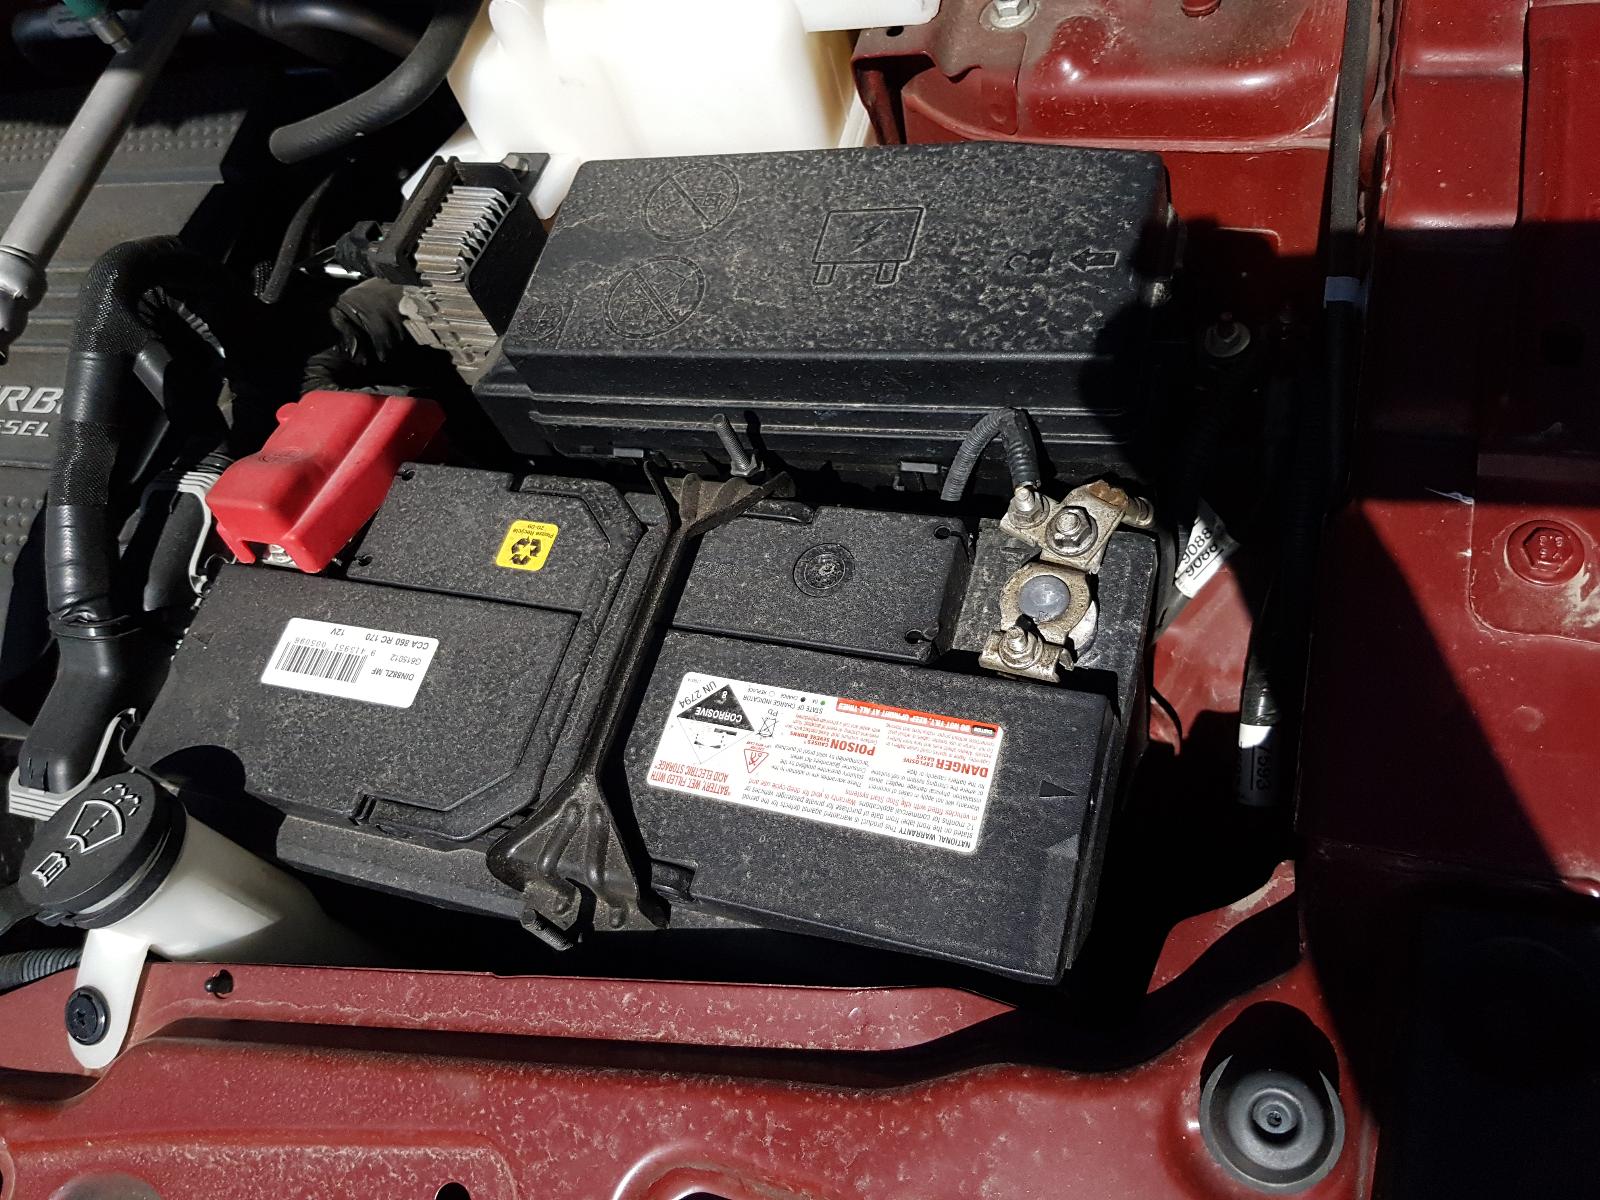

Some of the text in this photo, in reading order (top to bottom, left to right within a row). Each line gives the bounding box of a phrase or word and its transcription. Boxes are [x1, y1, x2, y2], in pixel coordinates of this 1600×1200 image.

[0, 386, 63, 414] RB
[0, 419, 49, 437] SEL
[1182, 528, 1212, 564] 9088
[329, 626, 429, 650] CCA 860 RC 170 12V
[370, 666, 383, 675] MF
[679, 681, 716, 708] UN 2794
[721, 690, 728, 699] 8
[741, 694, 772, 705] INDICATOR
[771, 699, 796, 709] CHARGE
[804, 705, 823, 714] STATE
[694, 706, 742, 722] CORROSIVE
[829, 738, 875, 756] POISON
[902, 756, 934, 767] EXPLOSIVE
[934, 758, 989, 777] DANGER
[649, 770, 667, 782] WITH
[683, 765, 713, 779] ELECTRIC
[712, 771, 728, 782] ACID
[665, 773, 687, 786] FILLED
[760, 796, 770, 804] the
[859, 818, 883, 829] product
[884, 813, 900, 823] from
[941, 817, 965, 828] months
[898, 826, 936, 840] WARRANTY
[931, 823, 942, 832] the
[936, 834, 971, 848] NATIONAL
